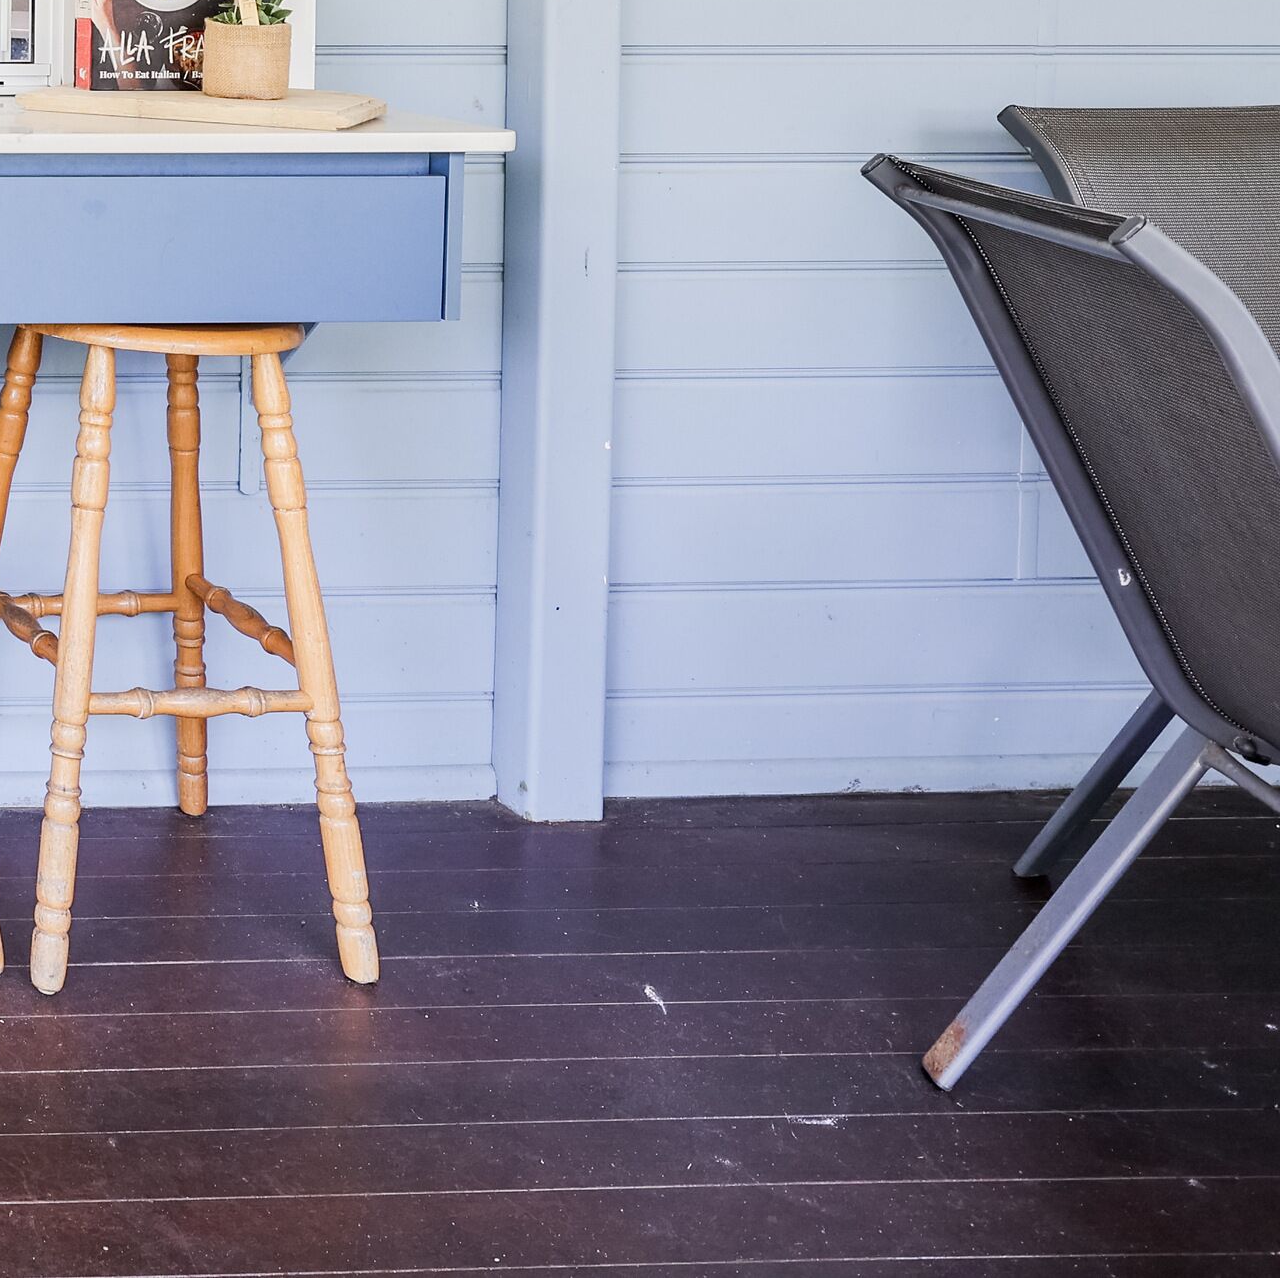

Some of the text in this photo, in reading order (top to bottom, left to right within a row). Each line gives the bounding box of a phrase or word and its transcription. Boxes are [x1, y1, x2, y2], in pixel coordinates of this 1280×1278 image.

[98, 25, 204, 71] ALLA FRA
[99, 70, 121, 79] How
[121, 70, 133, 79] To
[135, 70, 150, 79] Eat
[151, 70, 180, 79] Italian
